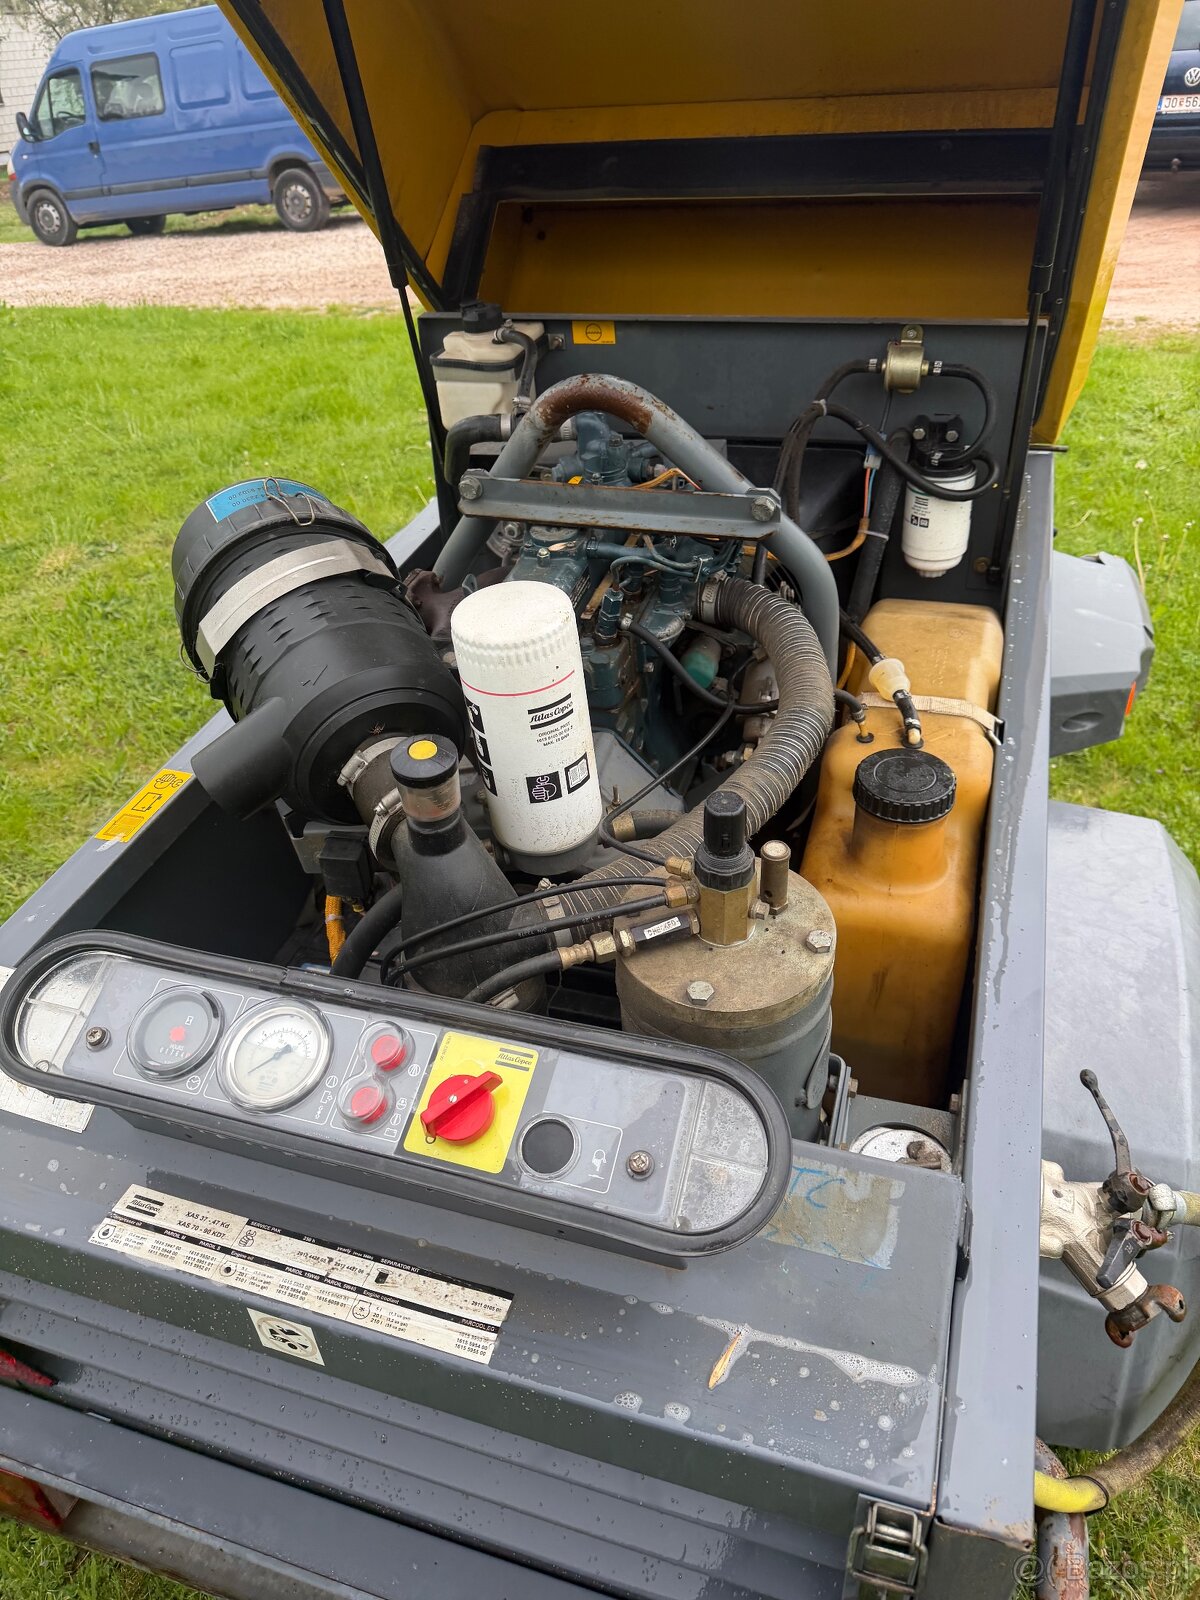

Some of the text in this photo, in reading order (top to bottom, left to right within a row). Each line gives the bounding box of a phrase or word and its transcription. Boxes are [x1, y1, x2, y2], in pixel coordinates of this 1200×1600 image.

[1164, 97, 1178, 108] JO
[529, 701, 574, 723] Atlas Copco
[498, 1053, 532, 1065] Atlas Copco
[130, 1199, 161, 1213] Atlas Copco
[186, 1211, 199, 1220] XAS
[220, 1221, 230, 1229] Kd
[177, 1220, 191, 1229] XAS
[203, 1227, 212, 1235] 90
[251, 1221, 271, 1231] SERVICE
[164, 1230, 181, 1239] PAROIL
[199, 1240, 216, 1249] PAROIL
[230, 1250, 246, 1259] Engine
[336, 1246, 351, 1255] yearly
[380, 1258, 411, 1270] SEPARATOR
[285, 1267, 320, 1280] PAROIL 15W40
[324, 1278, 342, 1287] PAROIL
[362, 1290, 400, 1305] Engine coolant
[461, 1319, 486, 1330] PARCOOL
